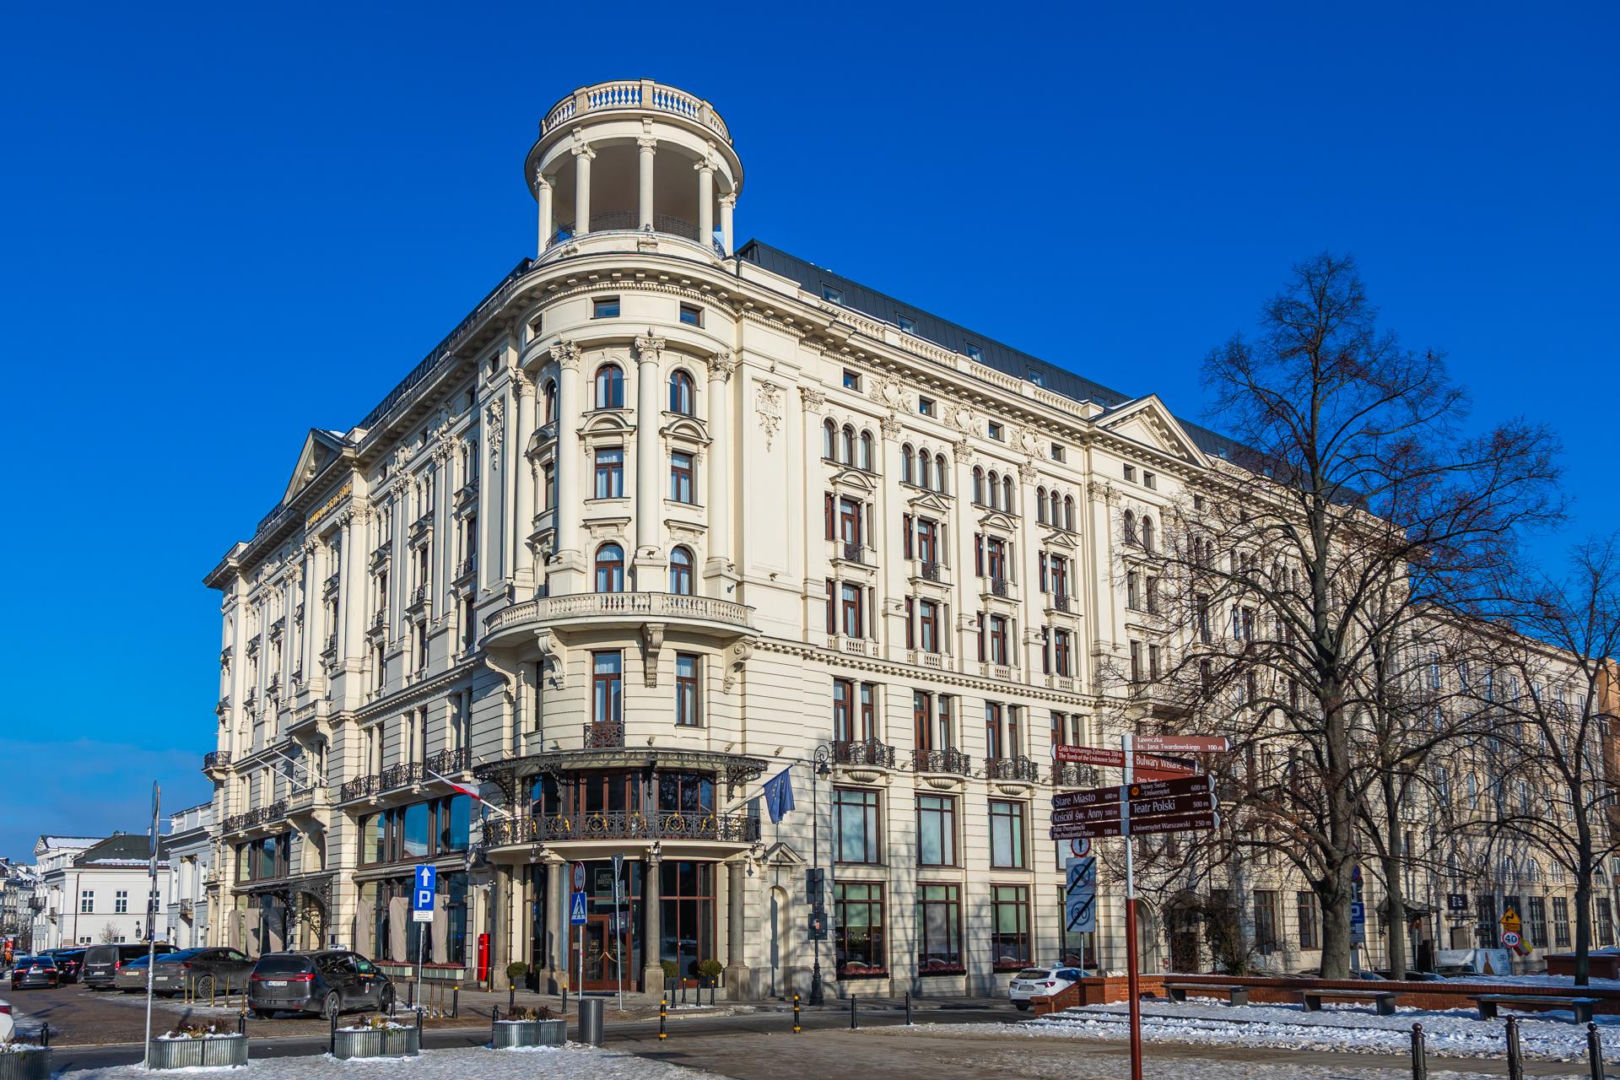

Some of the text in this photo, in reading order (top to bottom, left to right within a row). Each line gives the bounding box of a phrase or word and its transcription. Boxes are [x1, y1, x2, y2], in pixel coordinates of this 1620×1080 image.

[1147, 743, 1159, 751] Jana
[1135, 755, 1159, 769] Bulwary
[1055, 797, 1071, 807] Stare
[1073, 793, 1096, 804] Miasto
[1132, 803, 1151, 814] Teatr
[1152, 800, 1176, 812] Polski
[1088, 809, 1104, 820] Anny
[418, 890, 431, 908] P
[1504, 935, 1518, 943] 40
